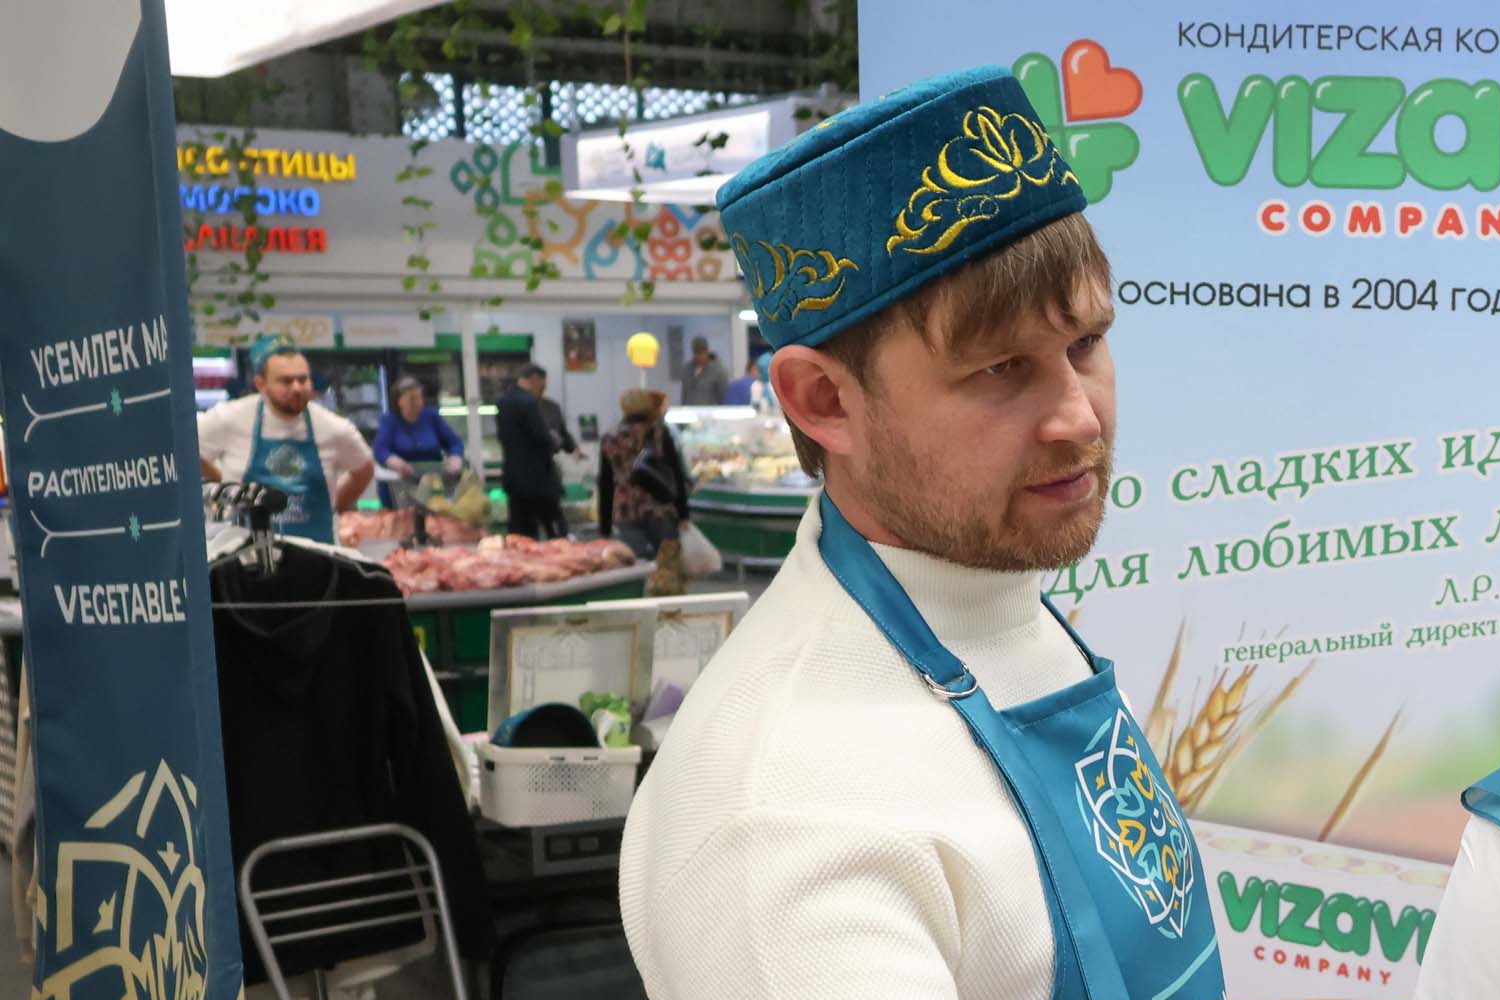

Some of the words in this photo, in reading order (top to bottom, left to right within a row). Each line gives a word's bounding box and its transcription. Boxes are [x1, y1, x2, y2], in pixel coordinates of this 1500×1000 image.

[1177, 22, 1442, 53] КОНДИТЕРСКАЯ
[1118, 280, 1311, 309] основана
[1324, 285, 1340, 309] в
[1352, 278, 1437, 311] 2004
[27, 455, 161, 498] РАСТИТЕЛЬНОЕ
[1171, 441, 1413, 502] сладких
[1045, 553, 1149, 604] для
[1177, 515, 1459, 581] любимых
[1434, 574, 1500, 607] Л.Р.
[1223, 622, 1393, 664] генеральный
[1254, 946, 1391, 985] COMPANY
